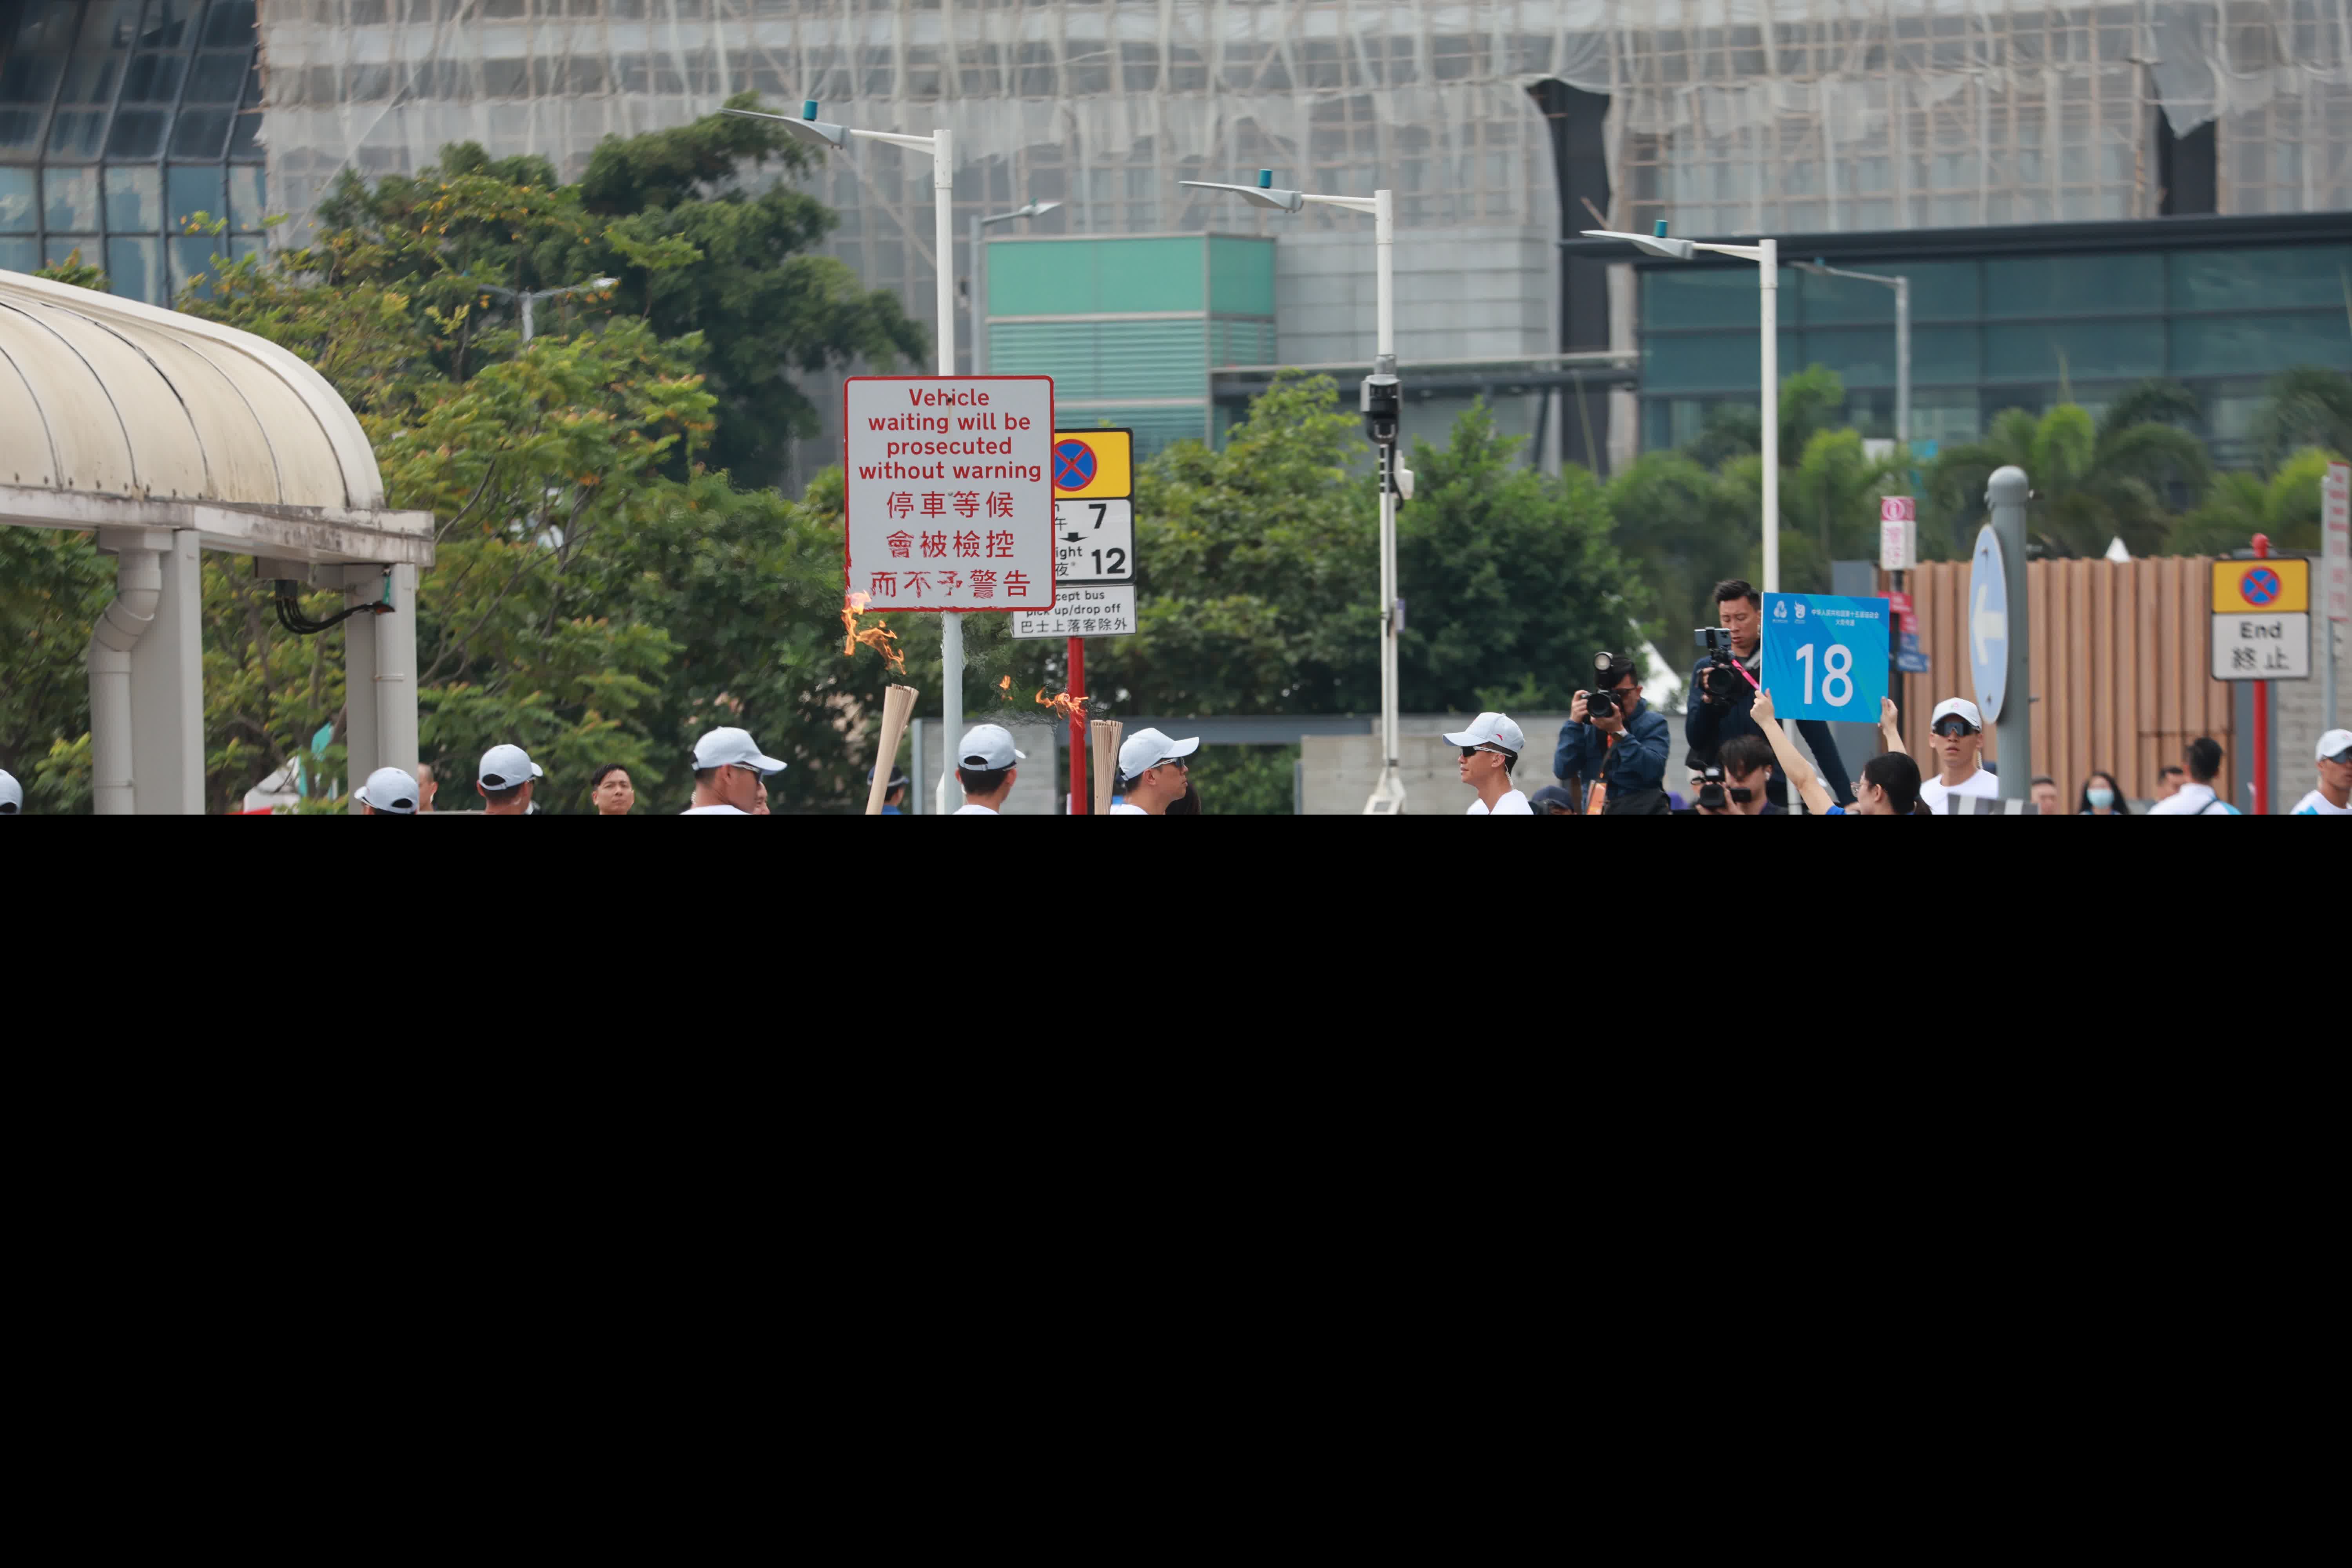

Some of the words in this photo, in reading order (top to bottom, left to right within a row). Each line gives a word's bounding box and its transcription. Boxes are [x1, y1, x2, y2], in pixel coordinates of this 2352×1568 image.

[909, 388, 989, 407] Vehicle
[869, 414, 949, 434] waiting
[958, 413, 996, 430] will
[1005, 413, 1031, 430] be
[887, 437, 1011, 458] prosecuted
[859, 461, 944, 479] without
[953, 461, 1041, 482] warning
[887, 491, 1013, 519] 停車等候
[1055, 517, 1067, 531] 午
[1088, 503, 1107, 529] 7
[887, 530, 1014, 558] 會被檢控
[1056, 546, 1082, 560] ight
[1055, 562, 1069, 576] 夜
[1091, 547, 1126, 575] 12
[870, 569, 1031, 598] 而不予警告
[1056, 592, 1080, 602] cept
[1085, 590, 1104, 600] bus
[1054, 604, 1100, 616] up/drop
[1105, 603, 1121, 613] off
[1021, 617, 1127, 634] 巴士上落客除外
[2240, 622, 2282, 639] End
[2232, 647, 2290, 670] 終止
[1796, 643, 1853, 706] 18
